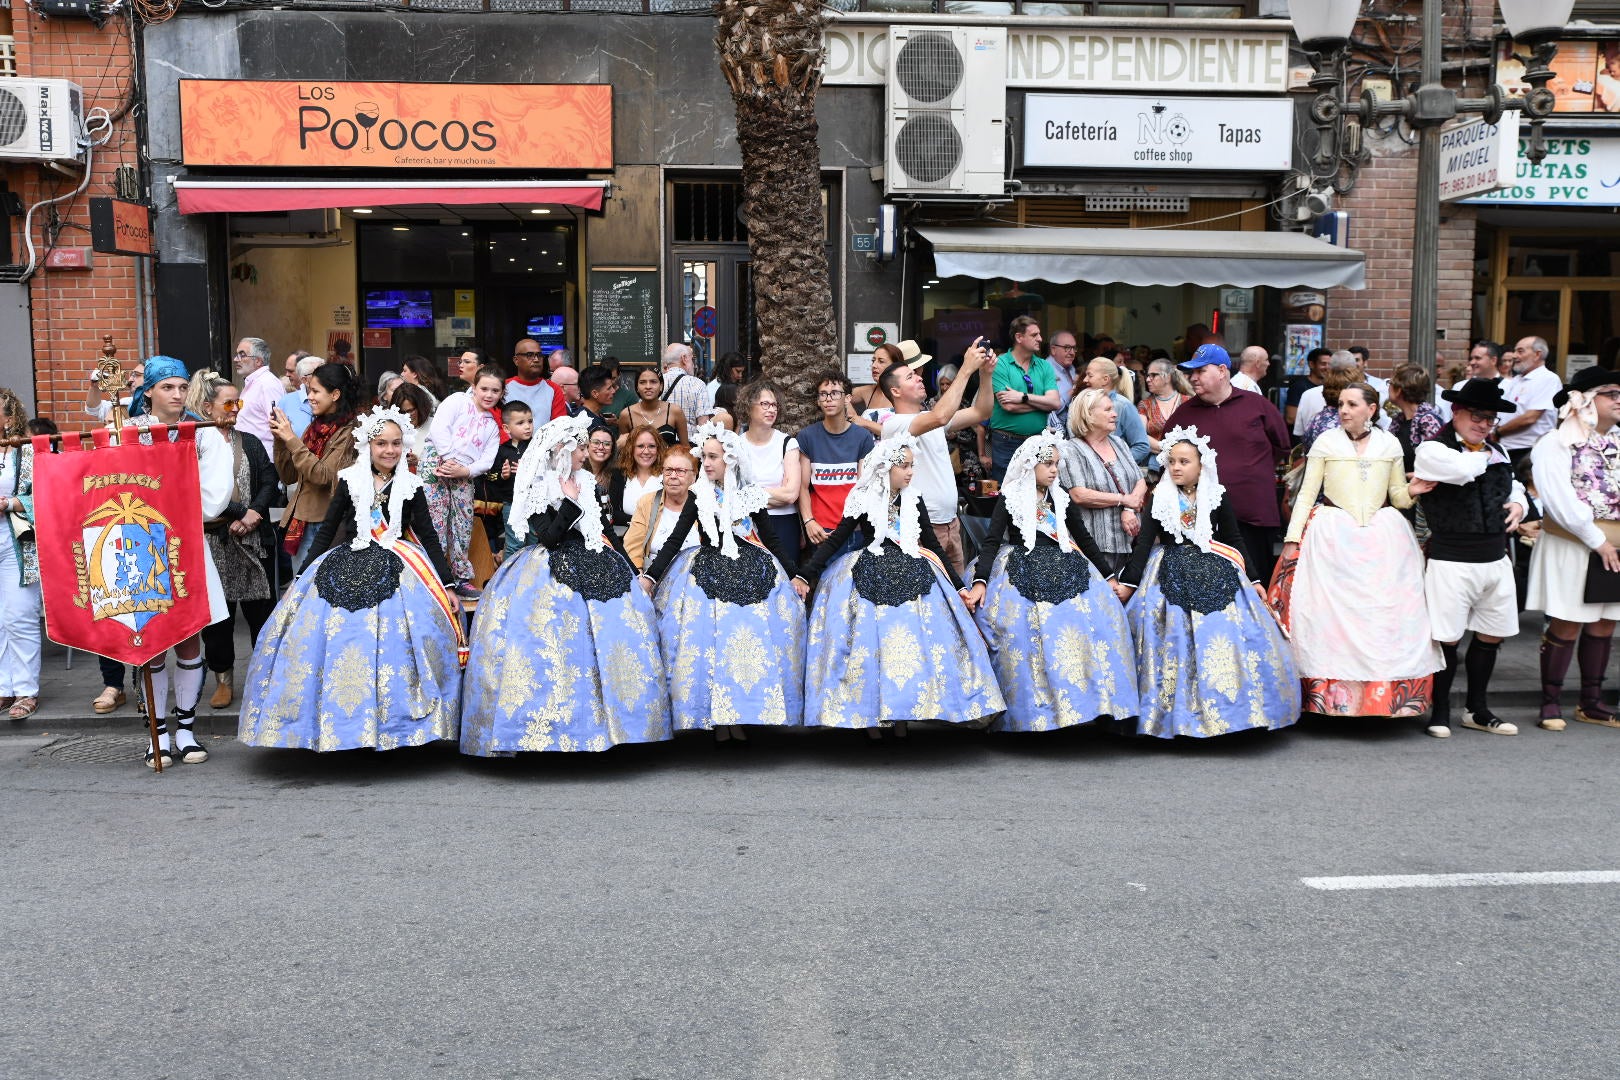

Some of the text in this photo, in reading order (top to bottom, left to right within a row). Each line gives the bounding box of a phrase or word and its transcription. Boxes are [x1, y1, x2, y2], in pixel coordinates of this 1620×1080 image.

[1045, 120, 1118, 141] Cafetería
[1218, 123, 1262, 147] Tapas
[433, 156, 447, 165] bar
[448, 158, 453, 166] y
[454, 156, 480, 165] mucho
[481, 156, 496, 165] más
[1134, 149, 1193, 164] coffee shop
[1447, 146, 1490, 174] MIGUEL
[1452, 177, 1465, 192] 965
[1467, 174, 1476, 188] 20
[1477, 172, 1487, 186] 84
[1488, 169, 1498, 183] 20
[1549, 186, 1589, 199] PVC
[857, 237, 870, 248] 55
[815, 468, 857, 480] TOKYO
